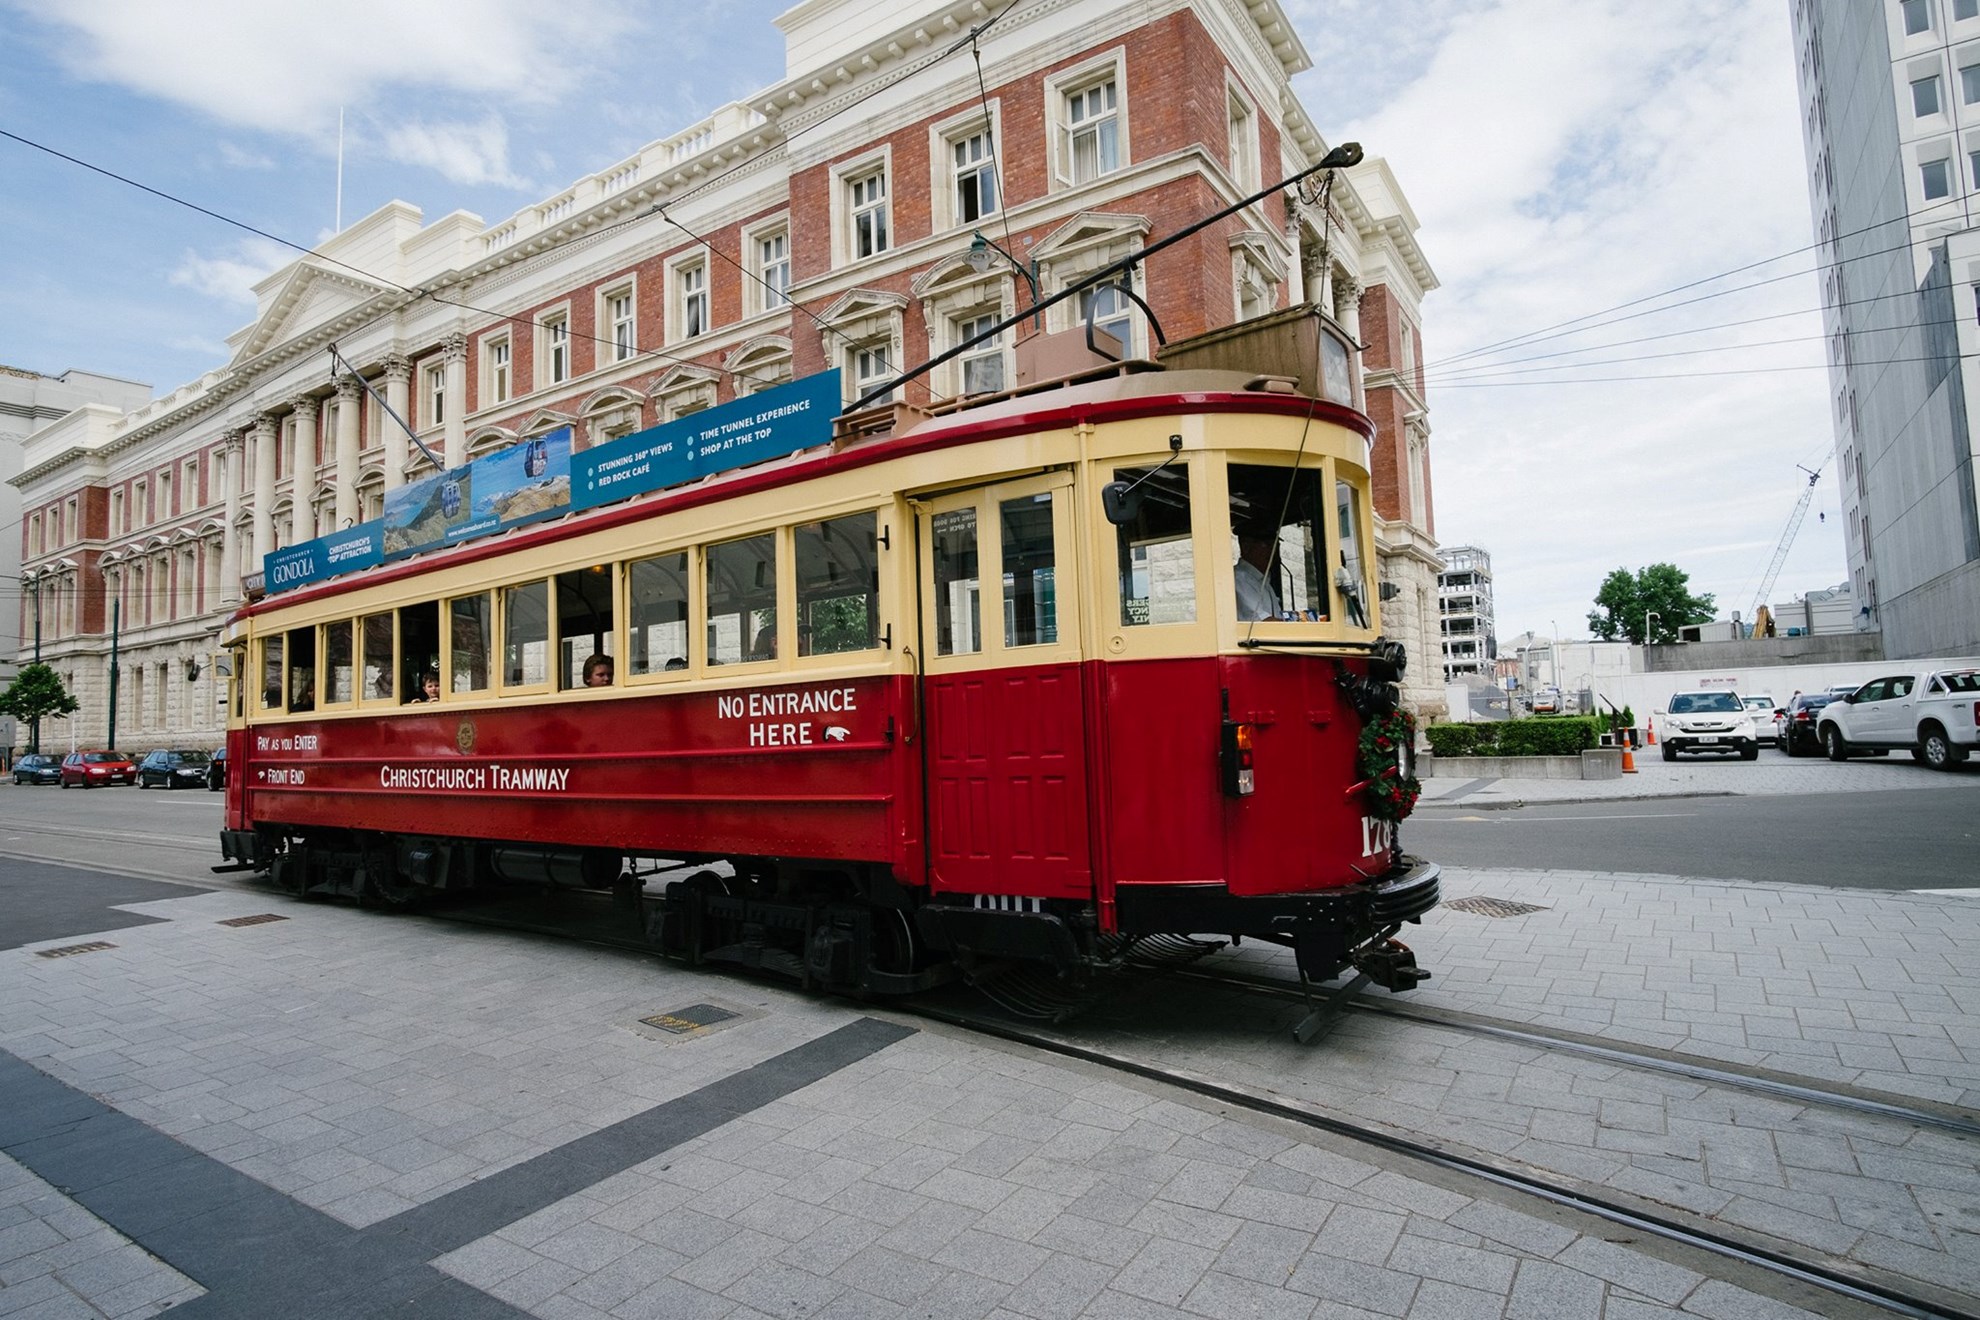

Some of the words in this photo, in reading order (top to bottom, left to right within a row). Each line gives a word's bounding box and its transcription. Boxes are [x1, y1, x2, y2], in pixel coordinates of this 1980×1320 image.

[700, 427, 720, 441] TIME
[721, 417, 754, 434] TUNNEL
[756, 399, 811, 424] EXPERIENCE
[700, 442, 722, 457] SHOP
[723, 439, 734, 450] AT
[736, 433, 753, 446] THE
[755, 427, 772, 440] TOP
[598, 454, 634, 473] STUNNING
[650, 442, 673, 457] VIEWS
[598, 476, 612, 487] RED
[612, 469, 631, 483] ROCK
[632, 461, 650, 477] CAFÉ
[328, 536, 371, 556] CHRISTCHURCH'S
[340, 544, 372, 562] ATTRACTION
[273, 557, 315, 584] GONDOLA
[718, 696, 744, 719] NO
[749, 688, 857, 717] ENTRANCE
[257, 736, 270, 751] PAY
[271, 739, 279, 751] AS
[280, 738, 292, 751] YOU
[294, 735, 317, 750] ENTER
[749, 722, 813, 747] HERE
[267, 769, 288, 784] FRONT
[290, 769, 305, 784] END
[380, 765, 485, 790] CHRISTCHURCH
[490, 765, 569, 791] TRAMWAY
